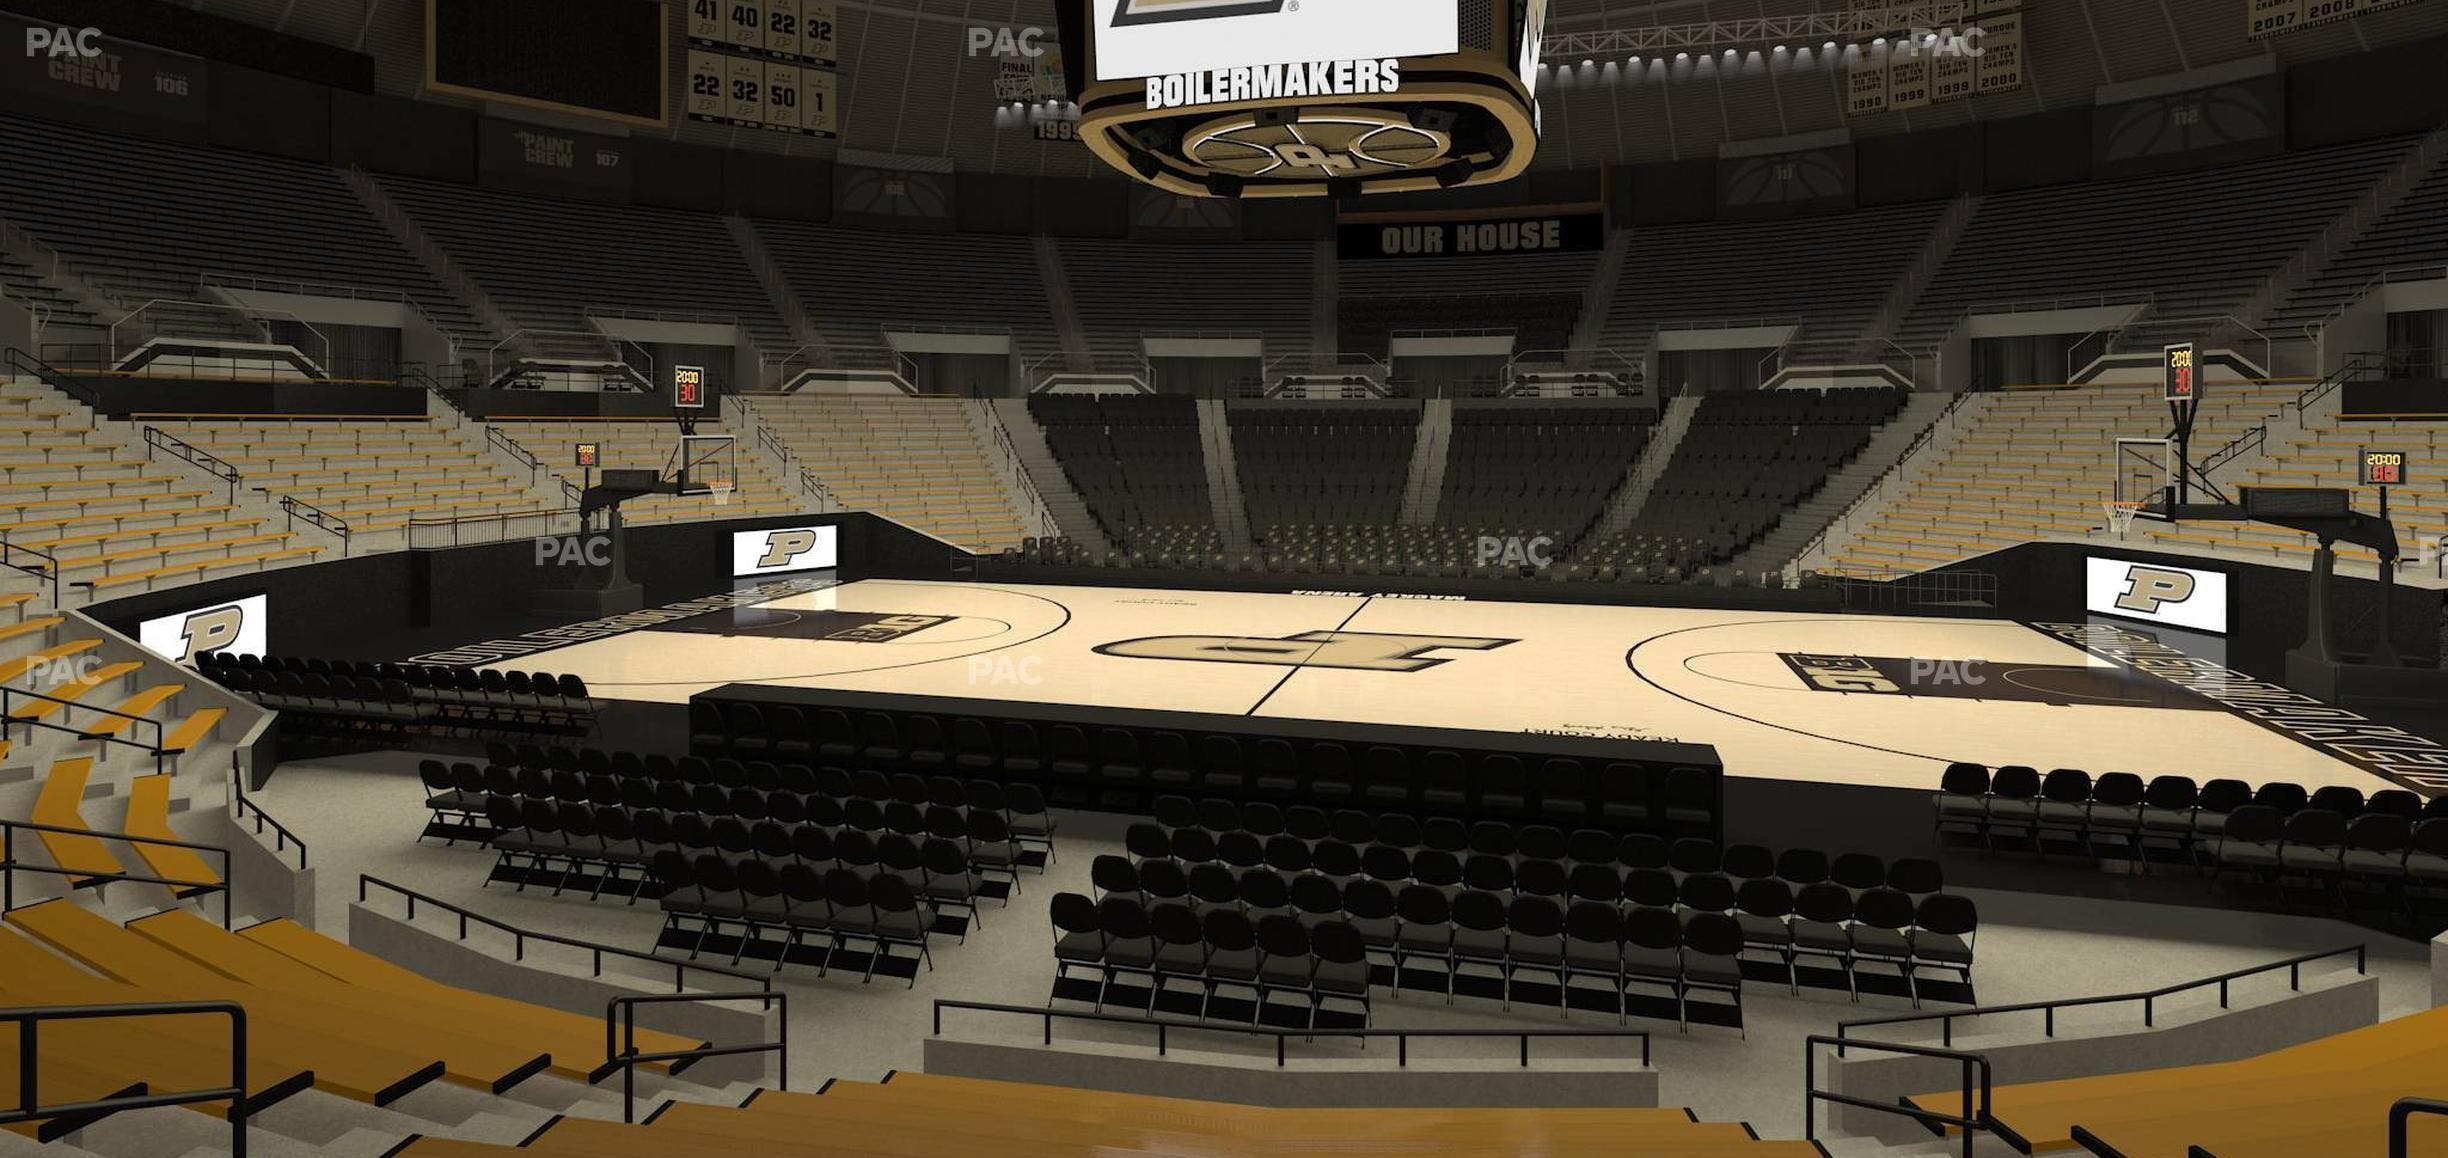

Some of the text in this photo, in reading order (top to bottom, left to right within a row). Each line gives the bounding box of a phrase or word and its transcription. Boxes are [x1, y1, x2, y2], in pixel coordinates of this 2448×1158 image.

[696, 0, 717, 20] 41
[732, 5, 758, 27] 40
[771, 12, 795, 35] 22
[808, 19, 832, 42] 32
[2254, 11, 2296, 33] 2007
[47, 60, 122, 92] CREW
[1002, 62, 1032, 73] FINAL
[154, 74, 189, 96] 106
[693, 74, 719, 97] 22
[733, 80, 758, 103] 32
[1146, 59, 1400, 110] BOILERMAKERS
[1938, 81, 1969, 96] 1999
[1982, 73, 2017, 88] 2000
[771, 86, 795, 108] 50
[815, 93, 823, 113] 1
[523, 132, 575, 154] PAINT
[525, 148, 575, 168] CREW
[595, 151, 620, 168] 107
[1381, 219, 1561, 255] OUR HOUSE
[677, 370, 699, 384] 20:00
[680, 384, 696, 402] 30
[2367, 453, 2401, 466] 20:00
[756, 529, 817, 568] P
[2113, 564, 2196, 614] P
